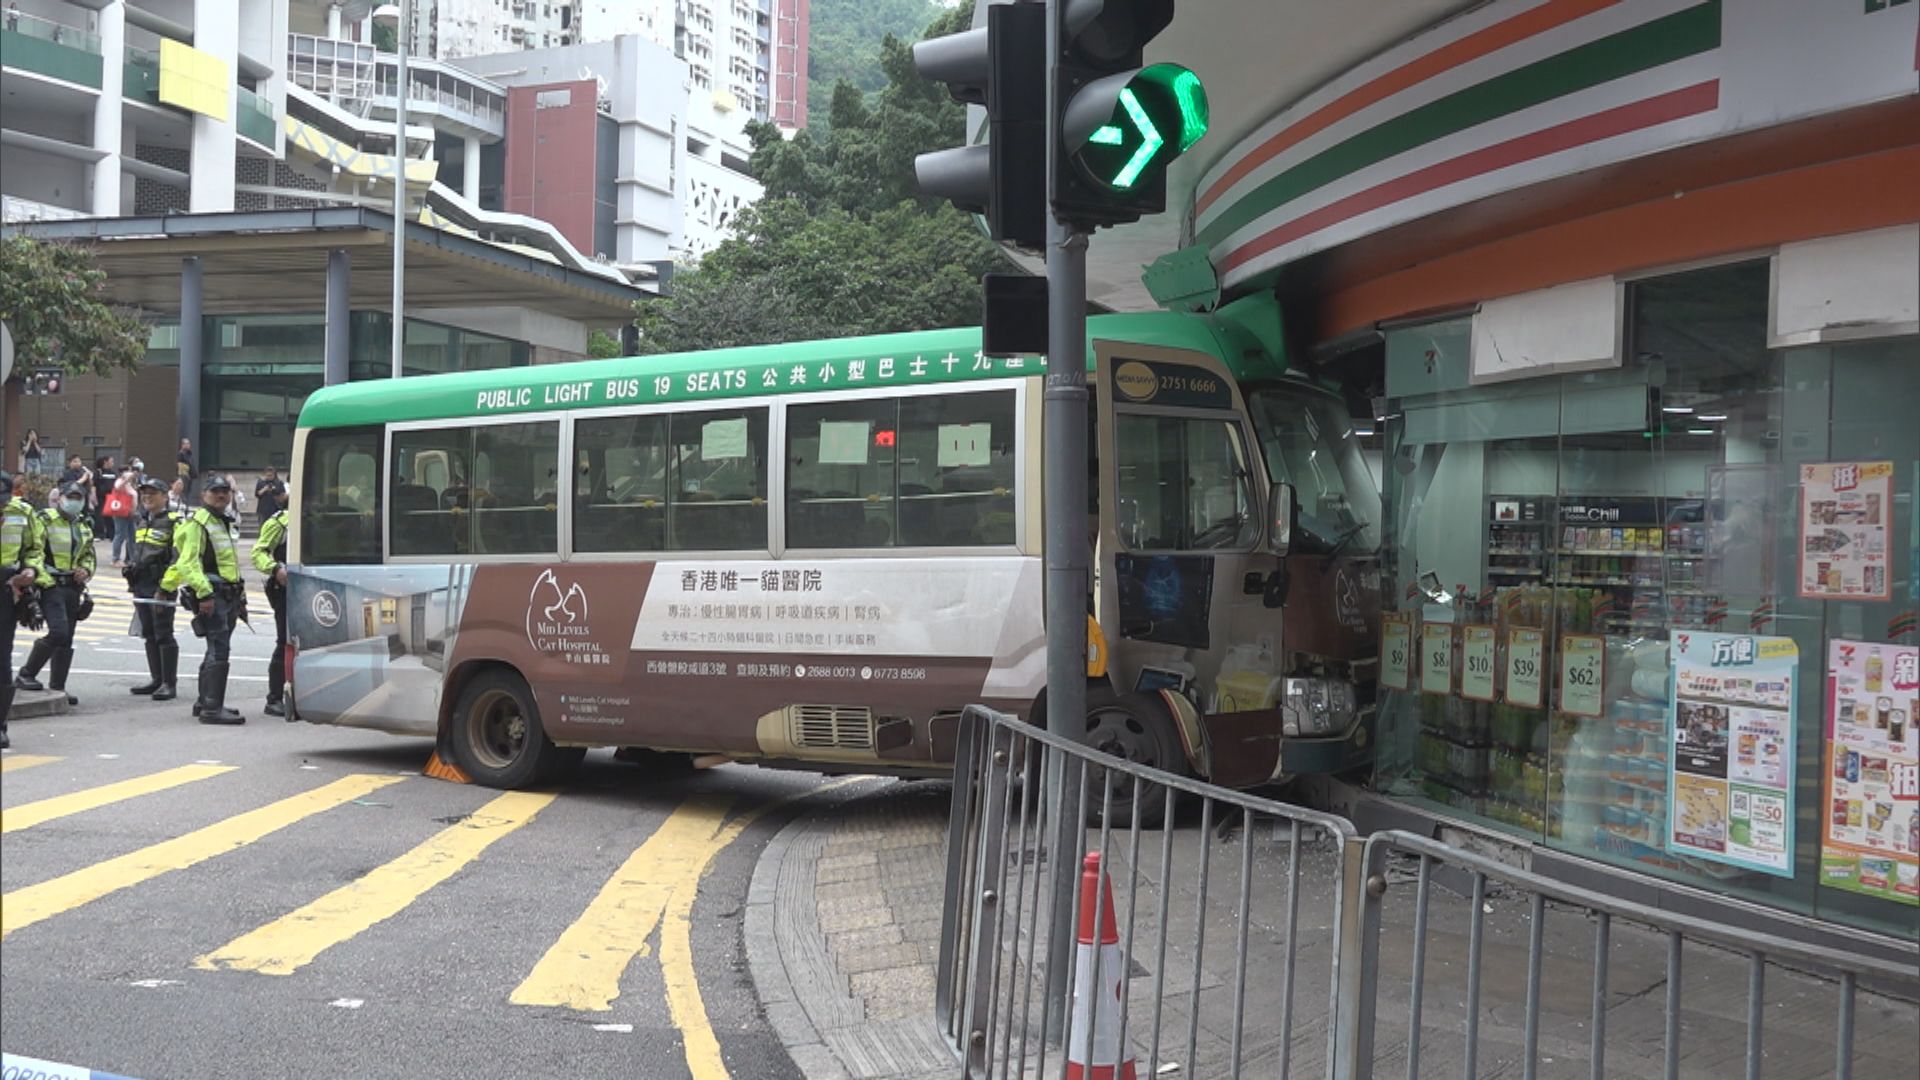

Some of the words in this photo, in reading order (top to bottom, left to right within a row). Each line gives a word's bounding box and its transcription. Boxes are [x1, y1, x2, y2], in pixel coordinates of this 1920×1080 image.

[762, 350, 1047, 386] 公共小型巴士十九
[476, 387, 532, 409] PUBLIC
[544, 382, 592, 404] LIGHT
[605, 379, 639, 400] BUS
[653, 375, 671, 396] 19
[686, 369, 747, 393] SEATS
[1161, 376, 1187, 390] 2751
[1189, 379, 1217, 393] 6666
[1587, 507, 1620, 521] Chill
[680, 569, 823, 592] 香港唯一貓醫院
[1711, 637, 1754, 667] 方便
